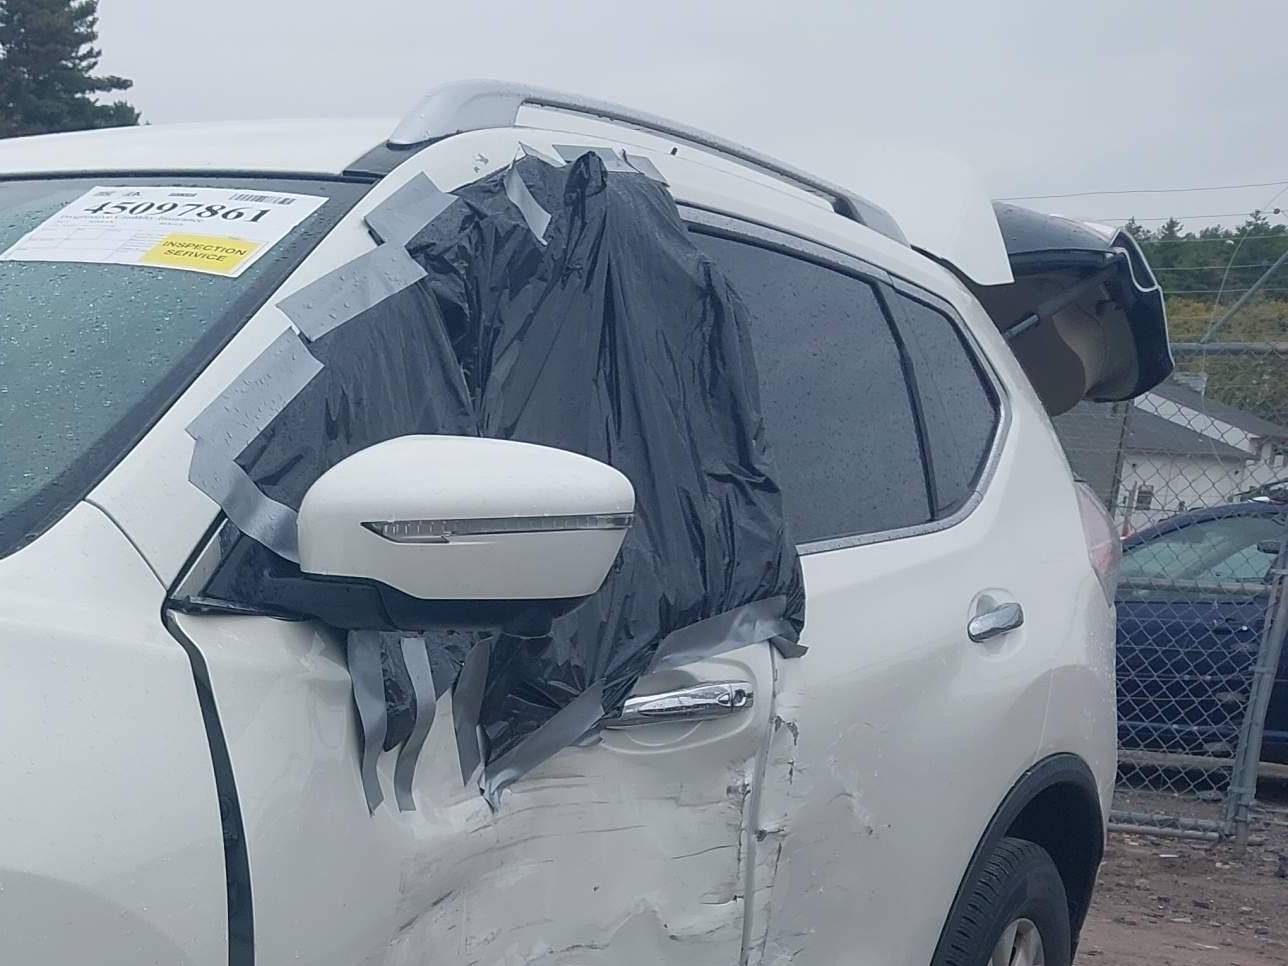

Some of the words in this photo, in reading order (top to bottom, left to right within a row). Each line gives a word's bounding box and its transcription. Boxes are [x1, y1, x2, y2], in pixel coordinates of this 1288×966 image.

[83, 201, 271, 222] 45097861
[163, 241, 247, 256] INSPECTION
[164, 249, 227, 262] SERVICE
